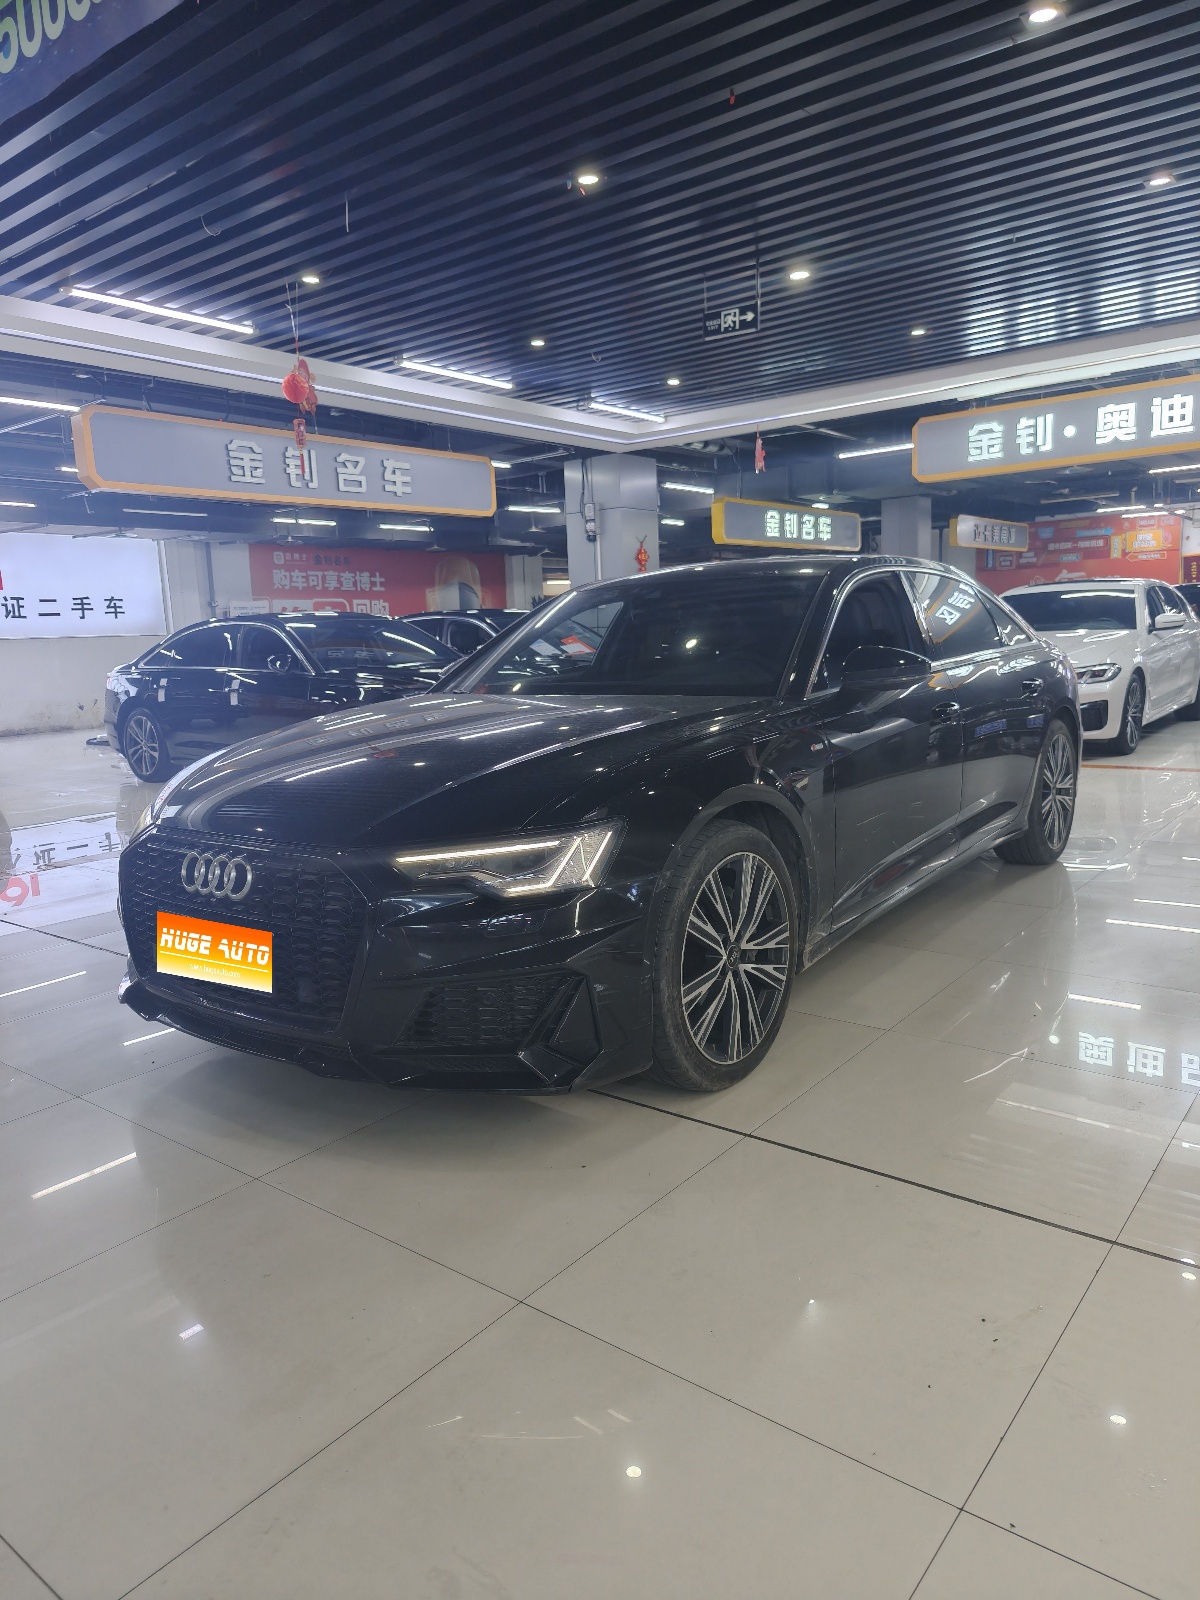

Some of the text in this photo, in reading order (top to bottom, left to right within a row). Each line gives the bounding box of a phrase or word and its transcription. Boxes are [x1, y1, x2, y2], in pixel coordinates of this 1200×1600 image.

[0, 0, 101, 73] 500
[226, 439, 412, 497] 金钊名车
[272, 569, 386, 592] 购车可享查博士
[1, 595, 126, 620] 证二手车
